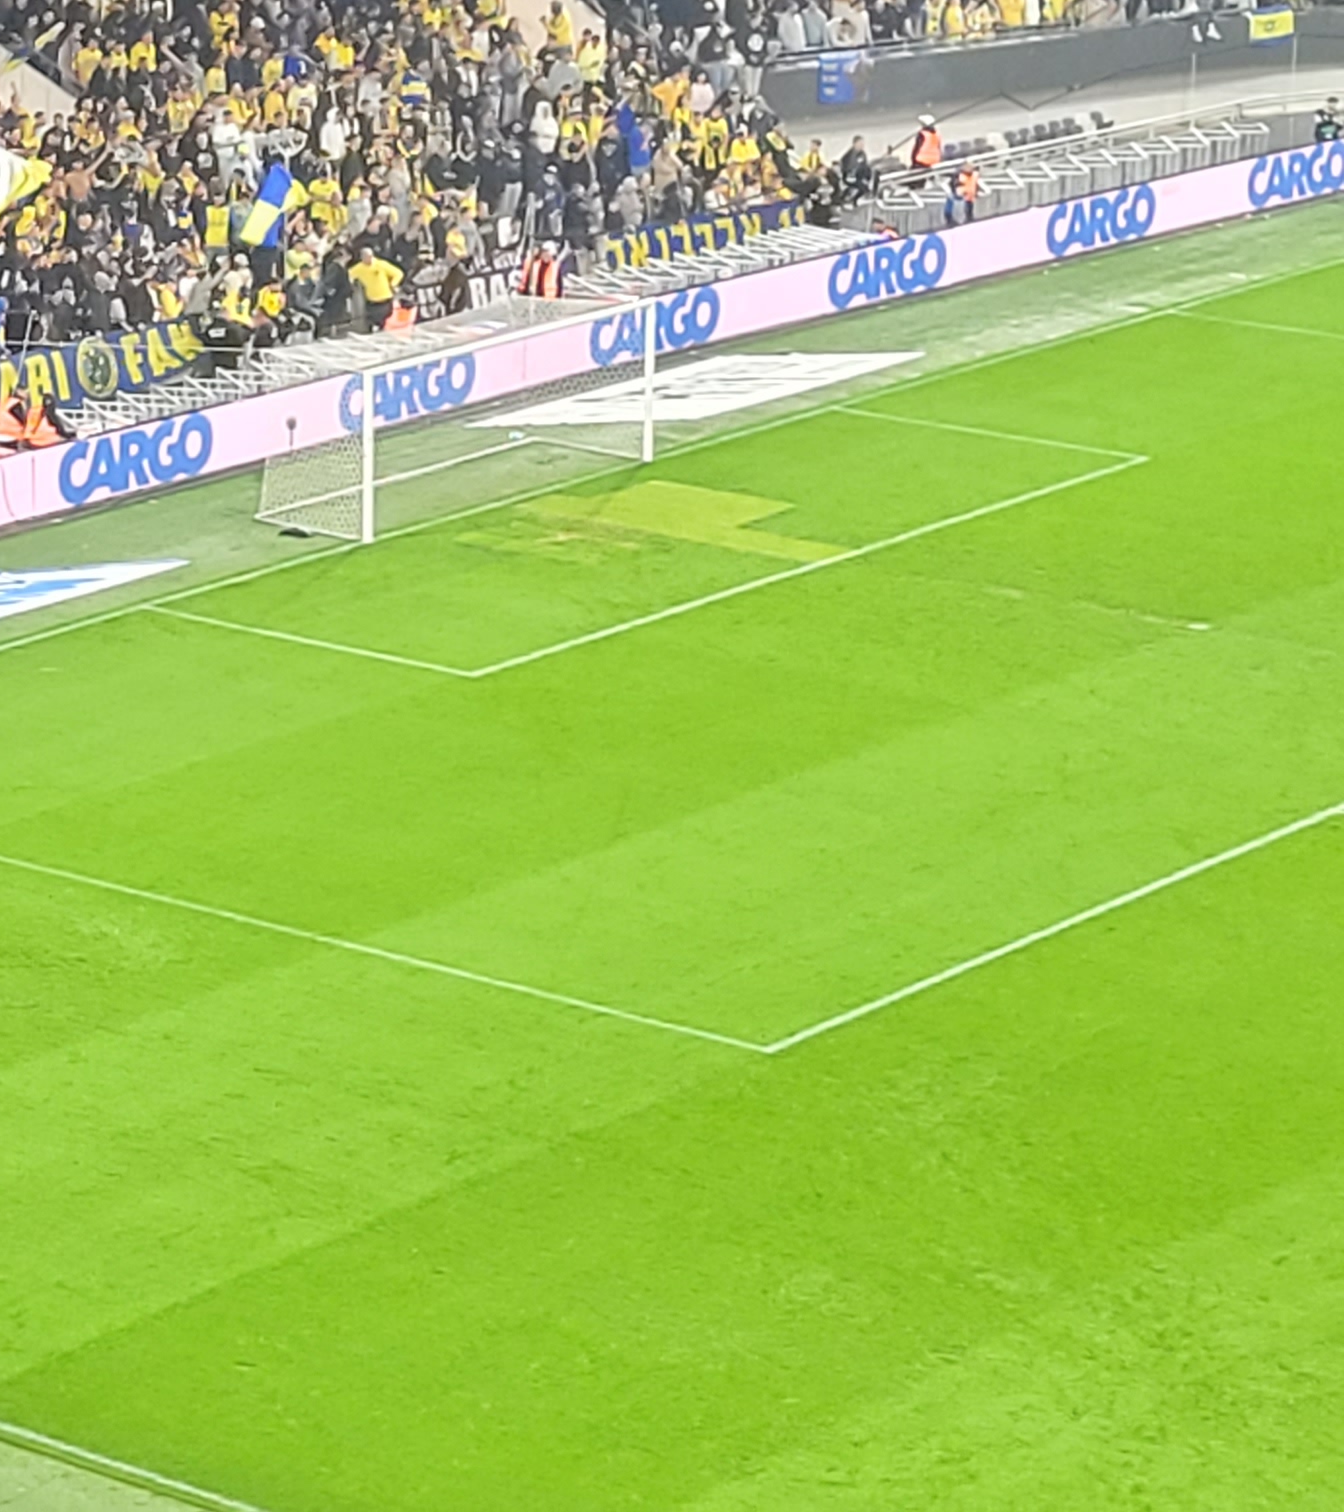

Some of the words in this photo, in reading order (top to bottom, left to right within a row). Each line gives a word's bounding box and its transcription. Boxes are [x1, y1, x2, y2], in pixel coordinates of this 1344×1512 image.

[1249, 140, 1344, 208] CARGO
[1047, 184, 1155, 256] CARGO
[829, 233, 946, 309] CARGO
[591, 285, 719, 366] CARGO
[339, 356, 475, 433] CARGO
[59, 412, 212, 505] CARGO
